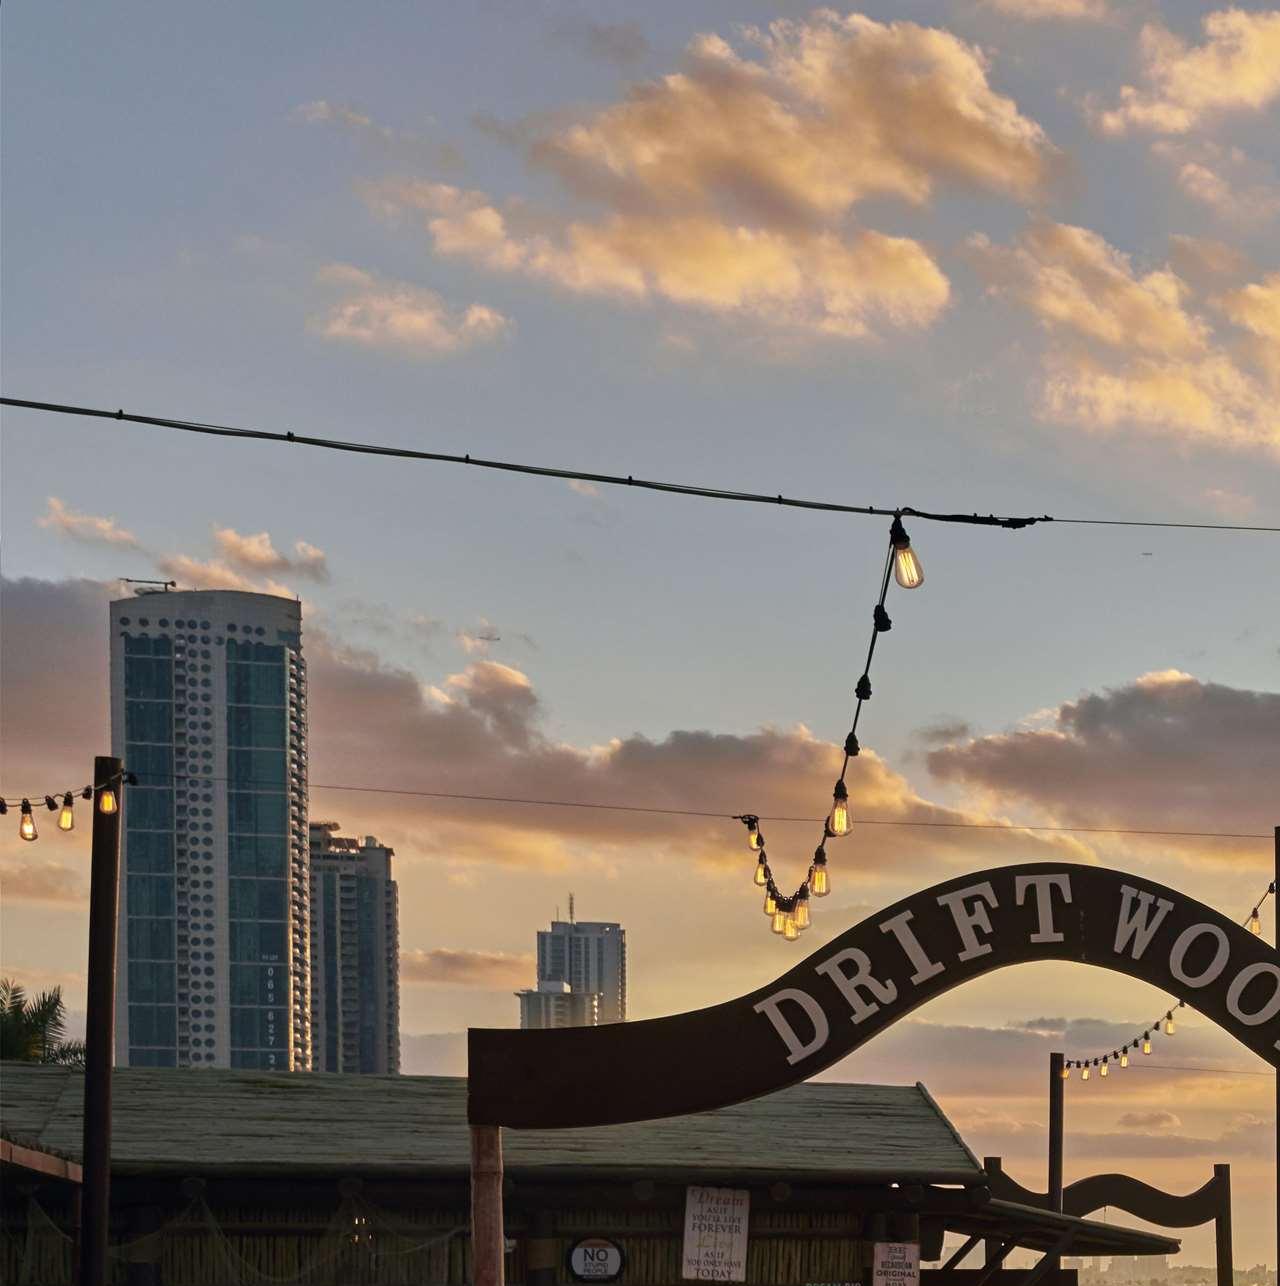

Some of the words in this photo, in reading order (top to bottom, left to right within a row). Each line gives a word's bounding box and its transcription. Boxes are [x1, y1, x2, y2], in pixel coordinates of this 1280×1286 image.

[753, 873, 1073, 1066] DRIFT
[692, 1223, 742, 1233] FOREVER
[583, 1248, 609, 1262] NO
[695, 1269, 732, 1279] TODAY
[876, 1270, 917, 1278] ORIGINAL
